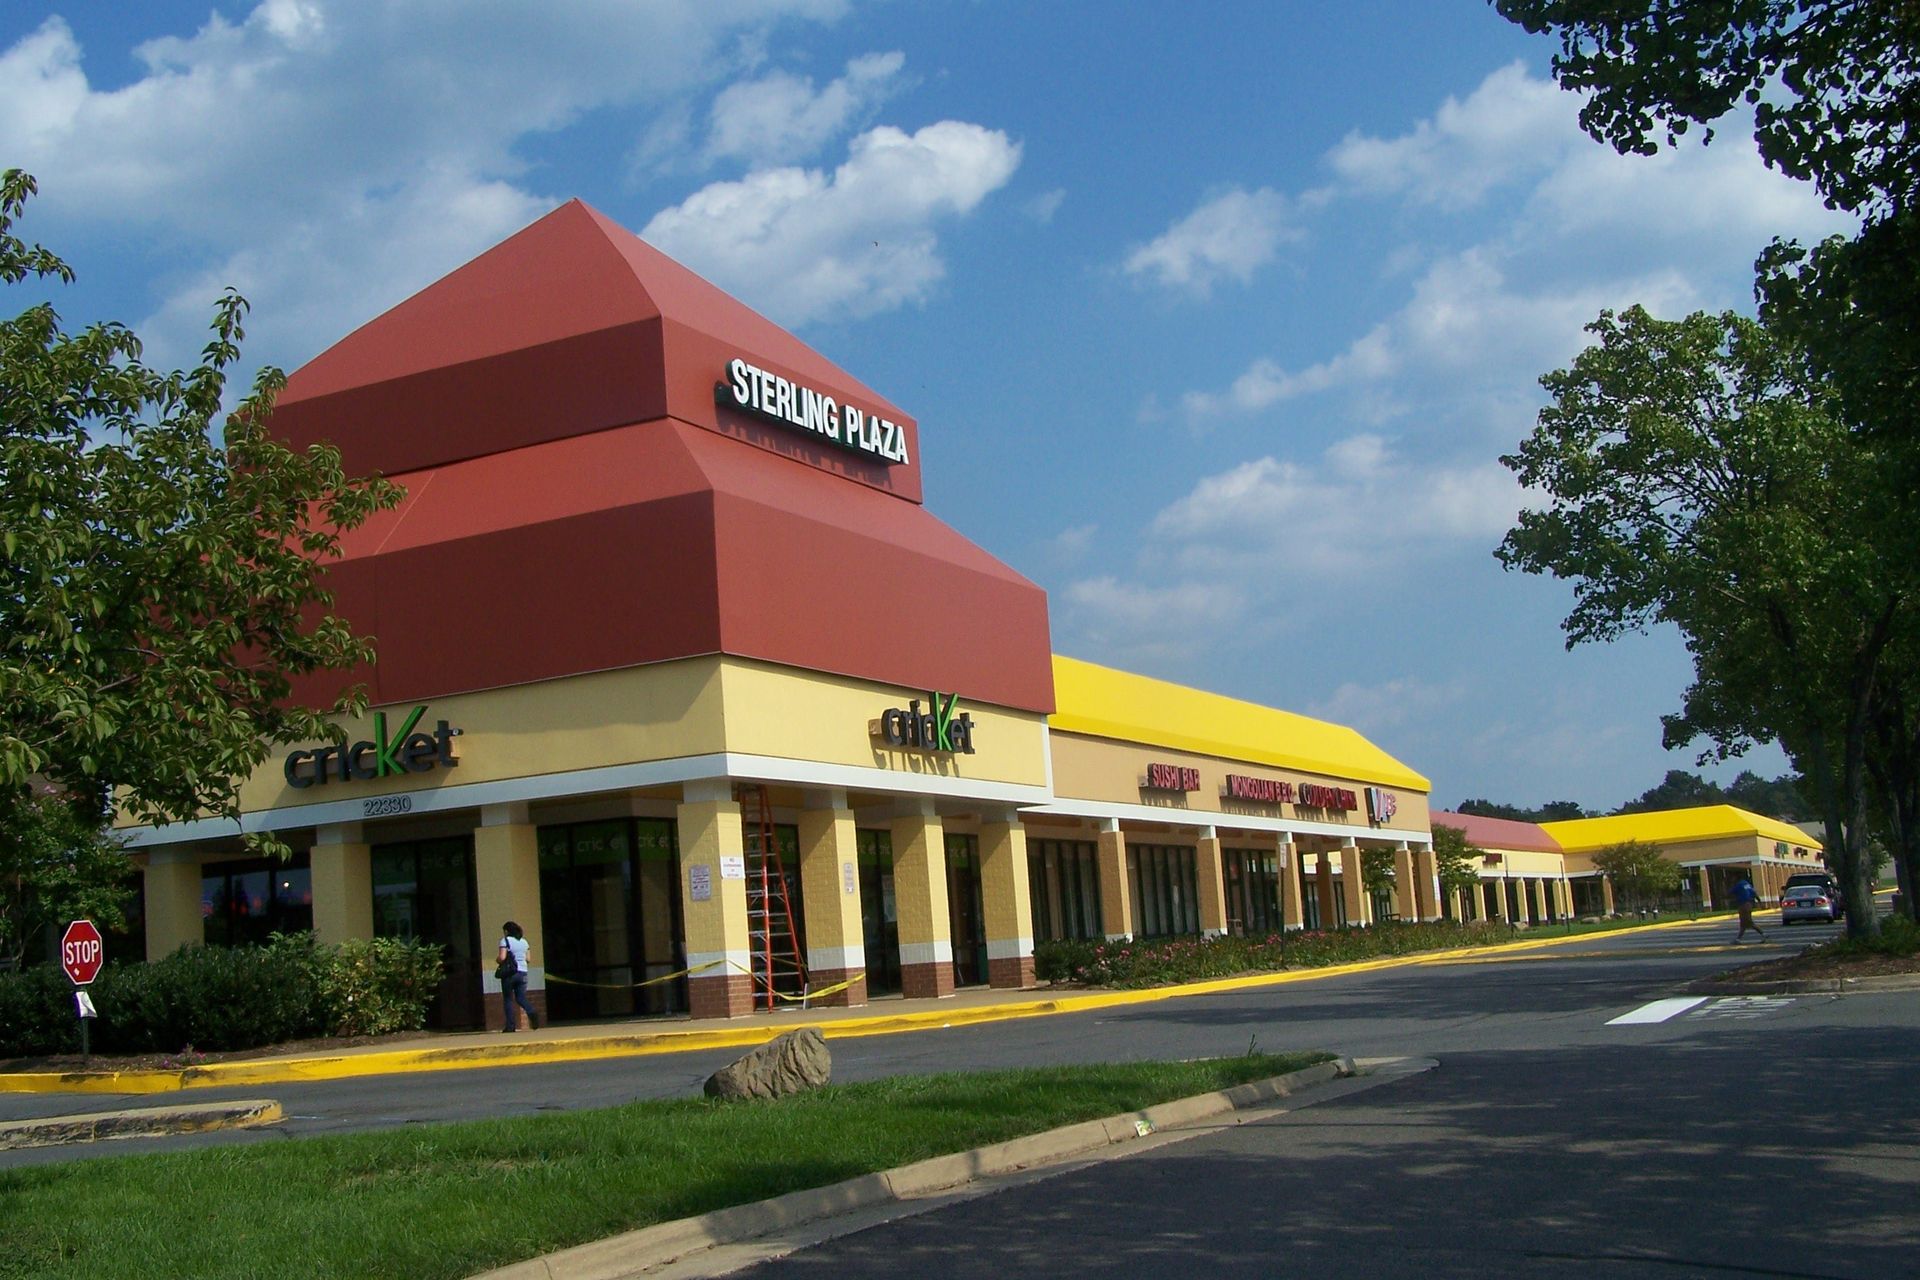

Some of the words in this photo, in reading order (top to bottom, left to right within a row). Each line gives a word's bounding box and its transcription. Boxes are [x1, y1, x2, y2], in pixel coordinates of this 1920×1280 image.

[730, 358, 839, 439] STERLING
[844, 404, 909, 465] PLAZA
[1151, 763, 1180, 790] SUSHI
[1182, 766, 1200, 791] BAR
[1230, 774, 1274, 801] MONGOLIAN
[364, 795, 411, 816] 22330
[65, 940, 100, 965] STOP
